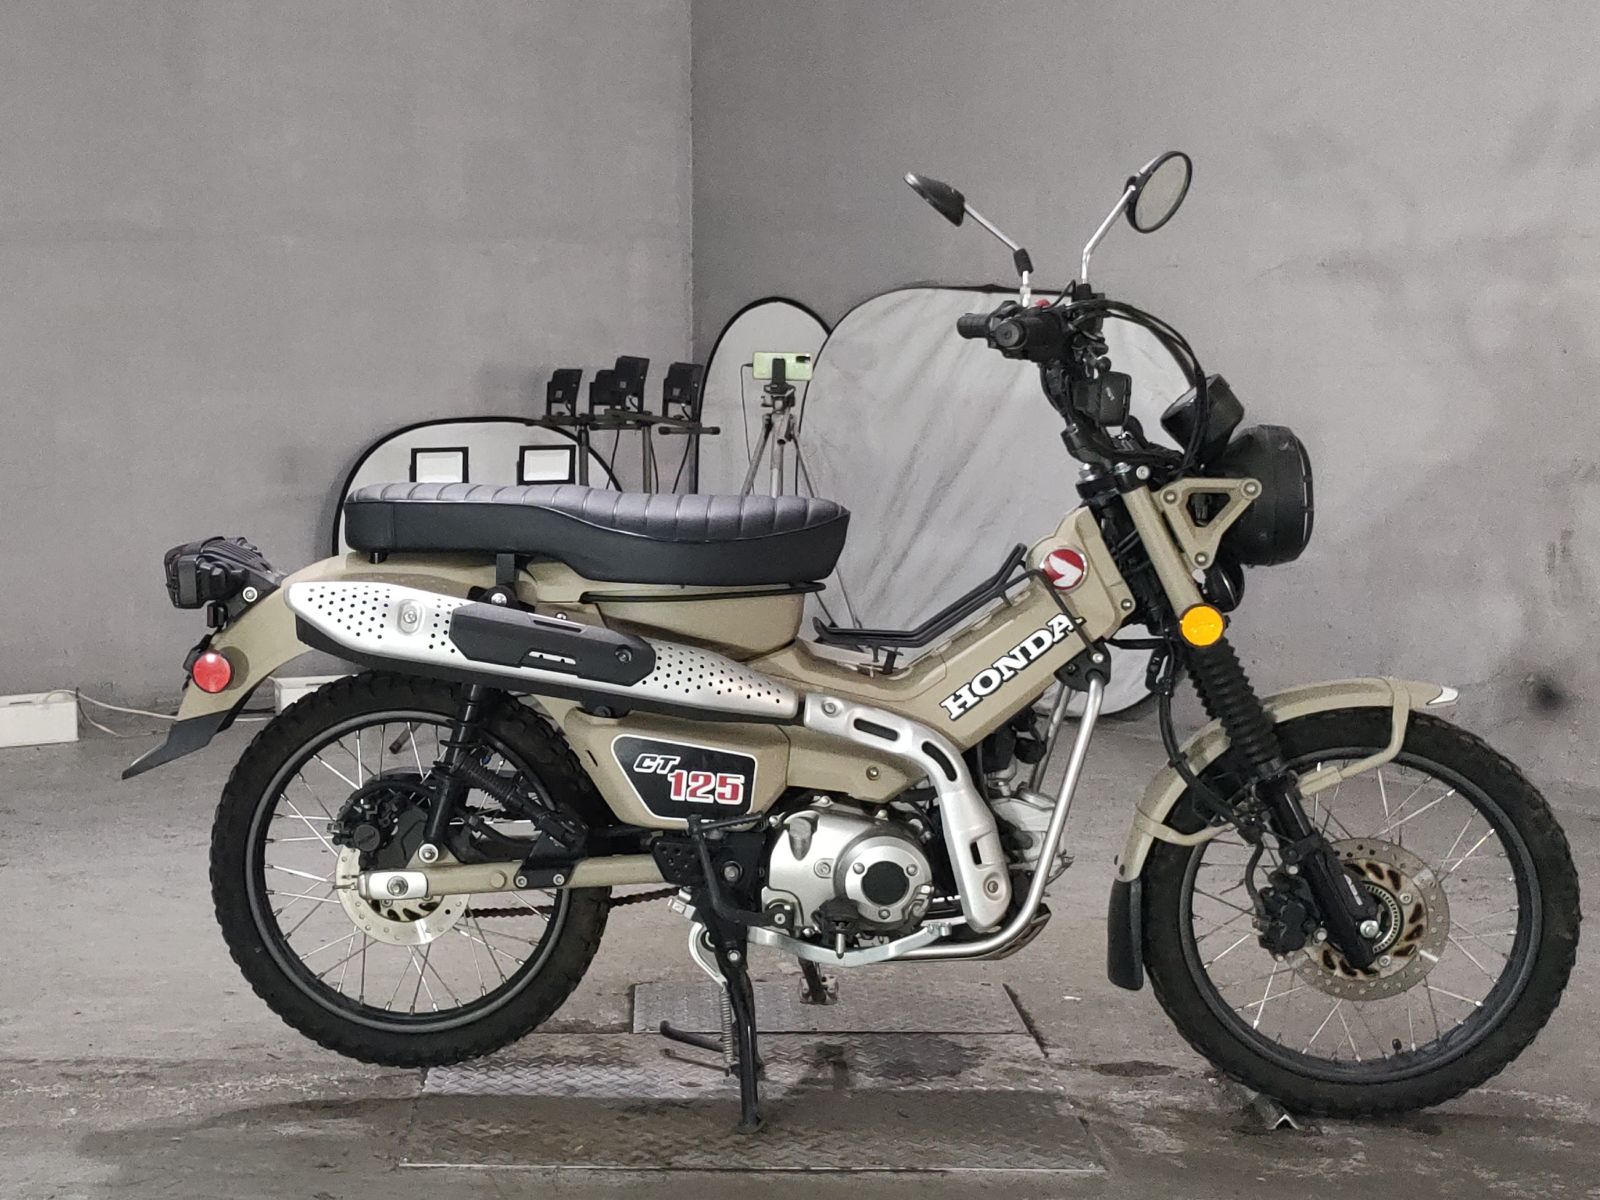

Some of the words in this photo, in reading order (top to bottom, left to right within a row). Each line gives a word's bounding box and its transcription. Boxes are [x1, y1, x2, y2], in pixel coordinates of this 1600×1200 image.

[939, 613, 1074, 721] HONDA
[633, 753, 681, 774] CT
[667, 770, 745, 805] 125
